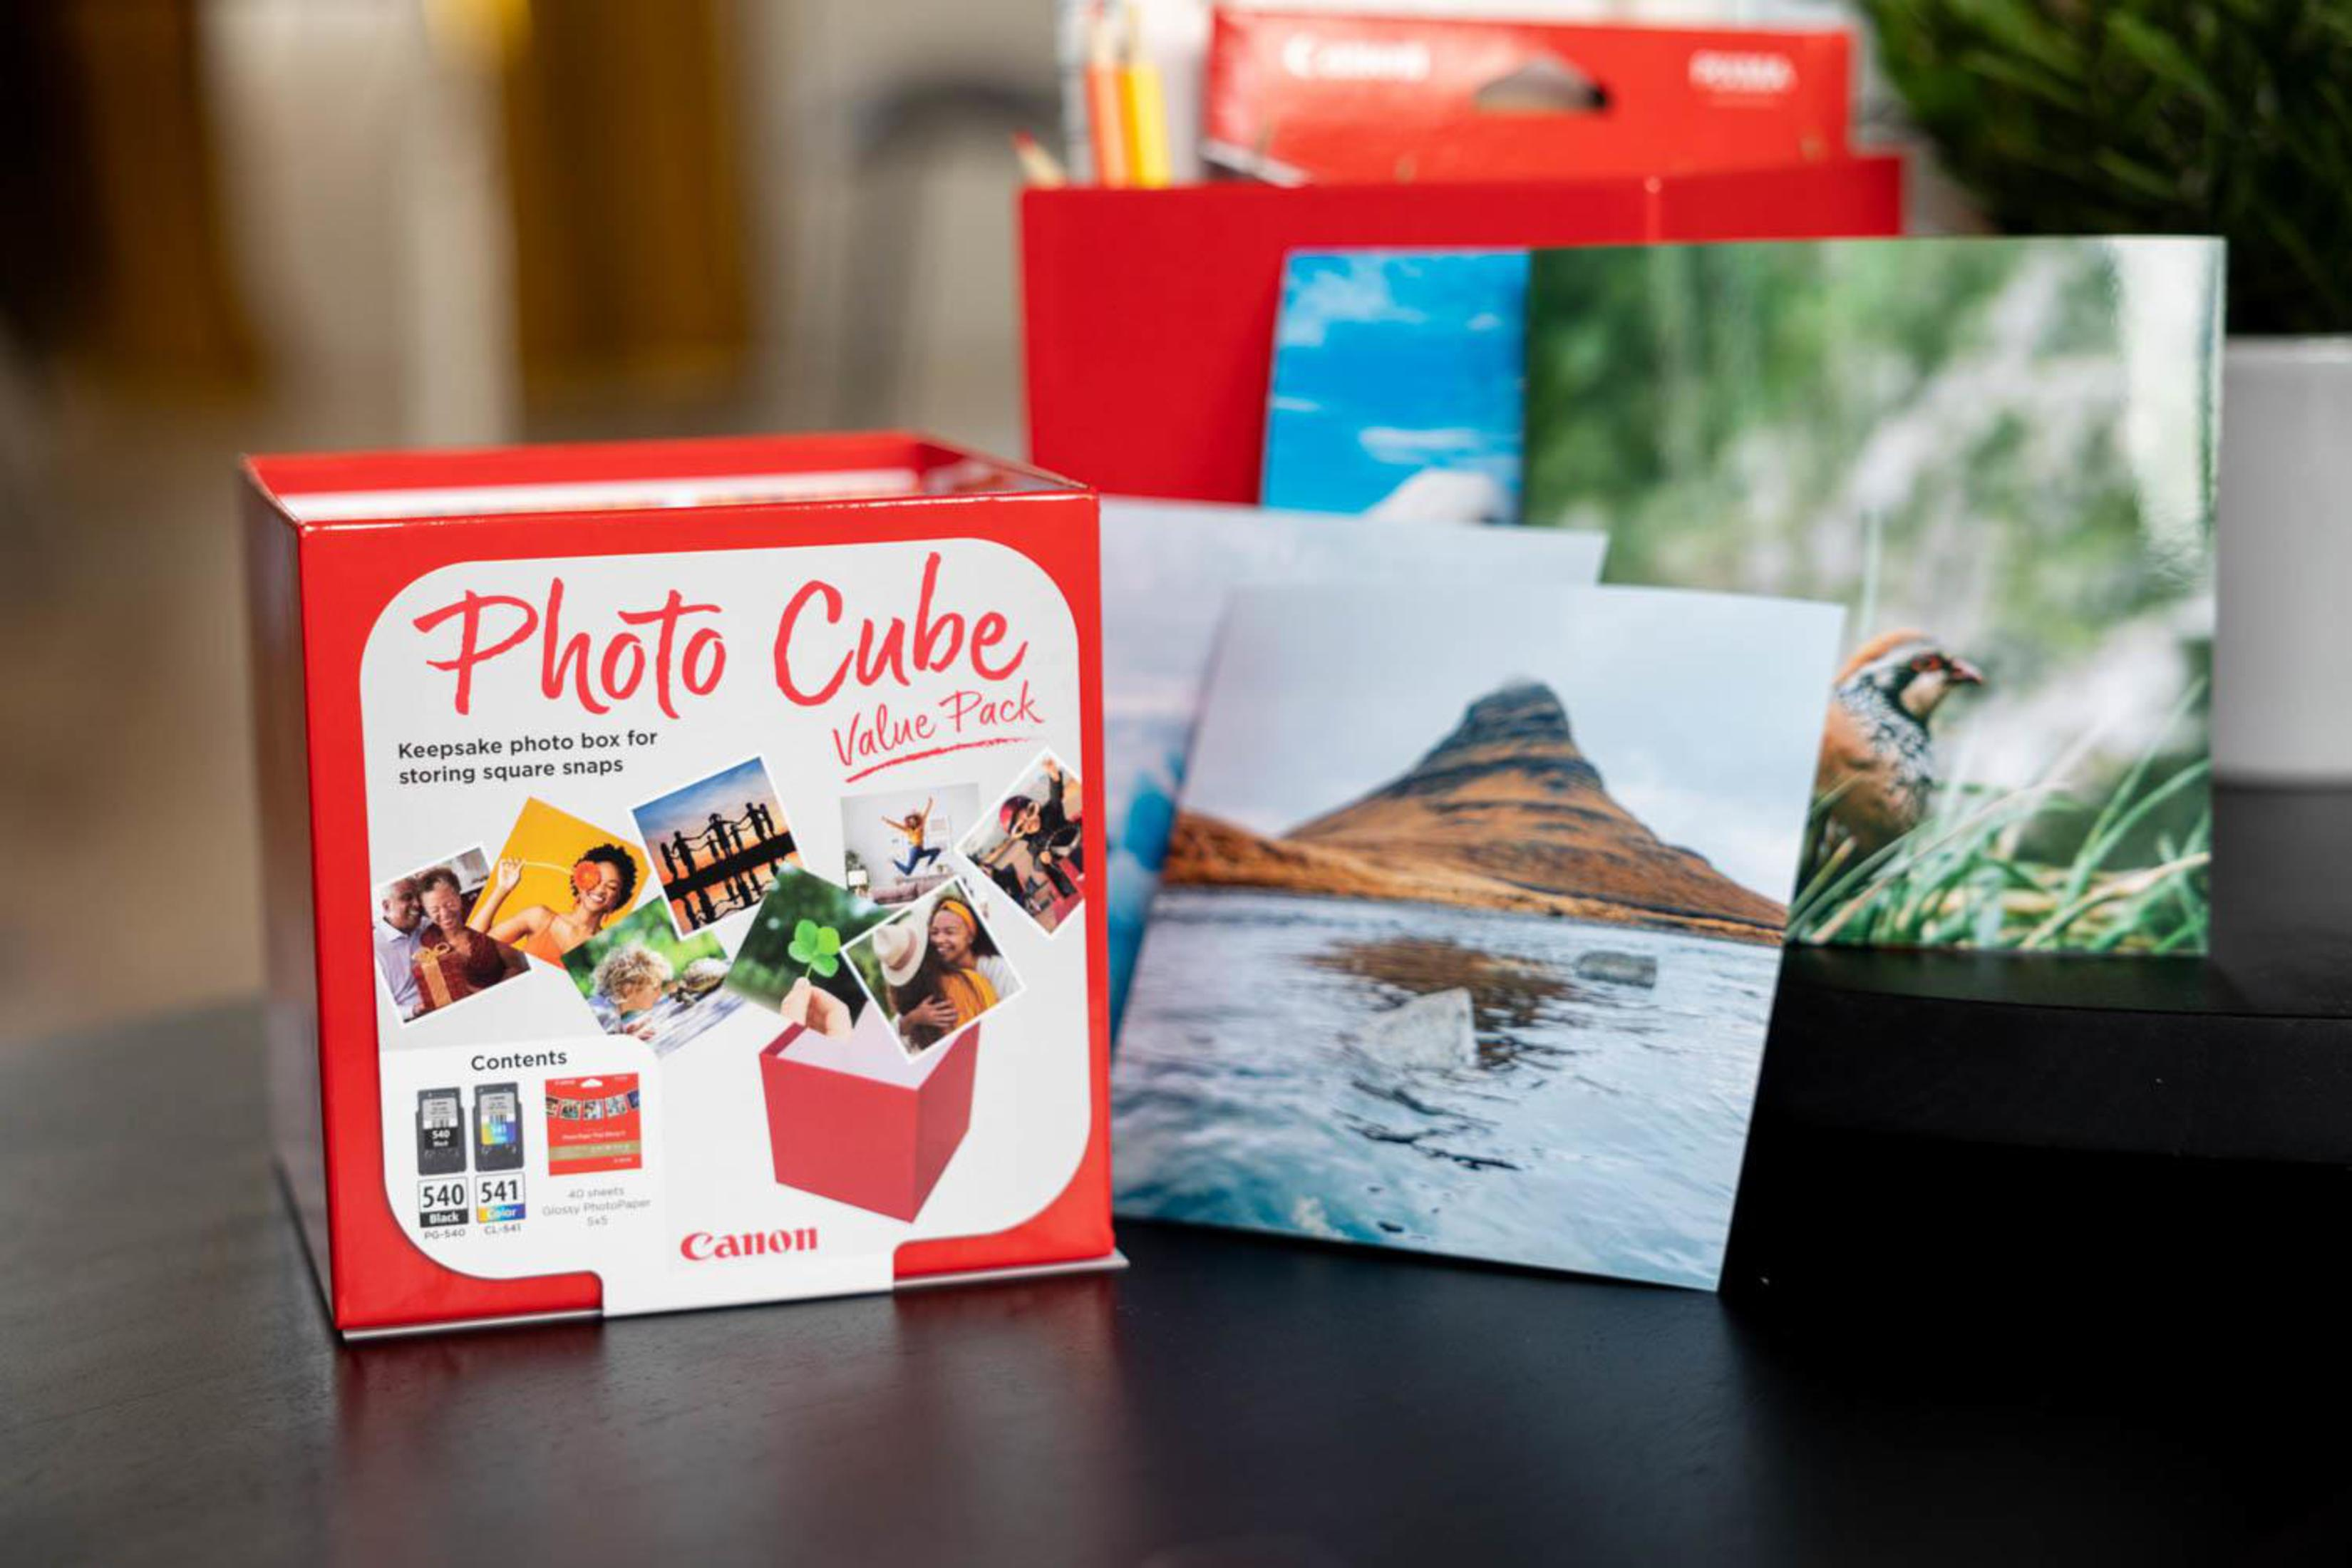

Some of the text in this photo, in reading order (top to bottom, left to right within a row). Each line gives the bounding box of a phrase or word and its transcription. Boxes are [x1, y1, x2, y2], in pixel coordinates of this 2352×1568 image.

[413, 552, 1028, 719] Photo Cube
[833, 680, 1045, 765] Value Pack
[398, 730, 658, 760] Keepsake photo box for
[399, 758, 624, 785] storing square snaps
[471, 1050, 567, 1071] Contents
[431, 1130, 450, 1139] 540
[423, 1184, 465, 1208] 540
[481, 1180, 517, 1203] 541
[587, 1187, 625, 1197] sheets
[429, 1212, 459, 1224] Black
[542, 1205, 580, 1217] Glossy
[424, 1229, 465, 1239] PG-540
[484, 1223, 522, 1235] CL-541
[680, 1227, 818, 1261] Canon
